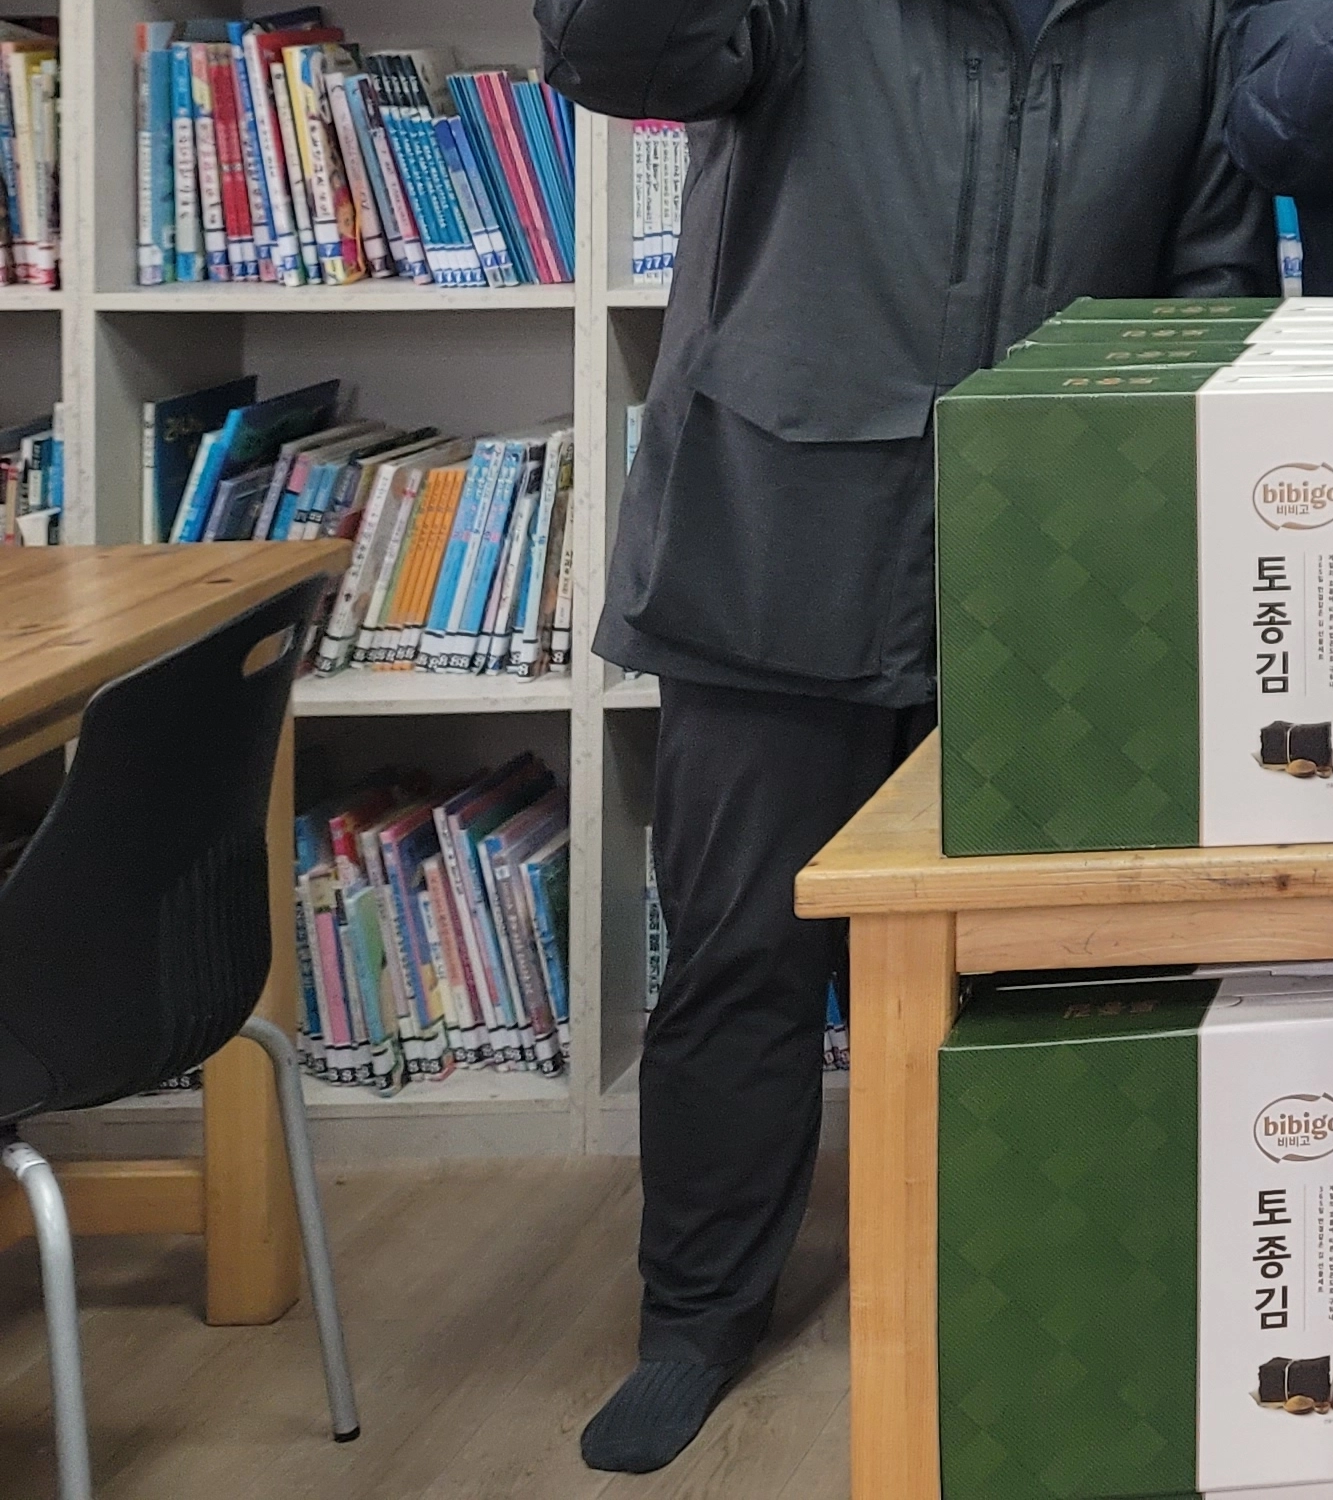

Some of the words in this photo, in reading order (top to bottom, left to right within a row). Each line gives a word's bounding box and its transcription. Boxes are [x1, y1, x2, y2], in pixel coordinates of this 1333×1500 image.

[1276, 503, 1310, 516] 비비고
[1252, 555, 1292, 694] 토종김
[1277, 1134, 1312, 1148] 비비고
[1251, 1188, 1292, 1331] 토종김
